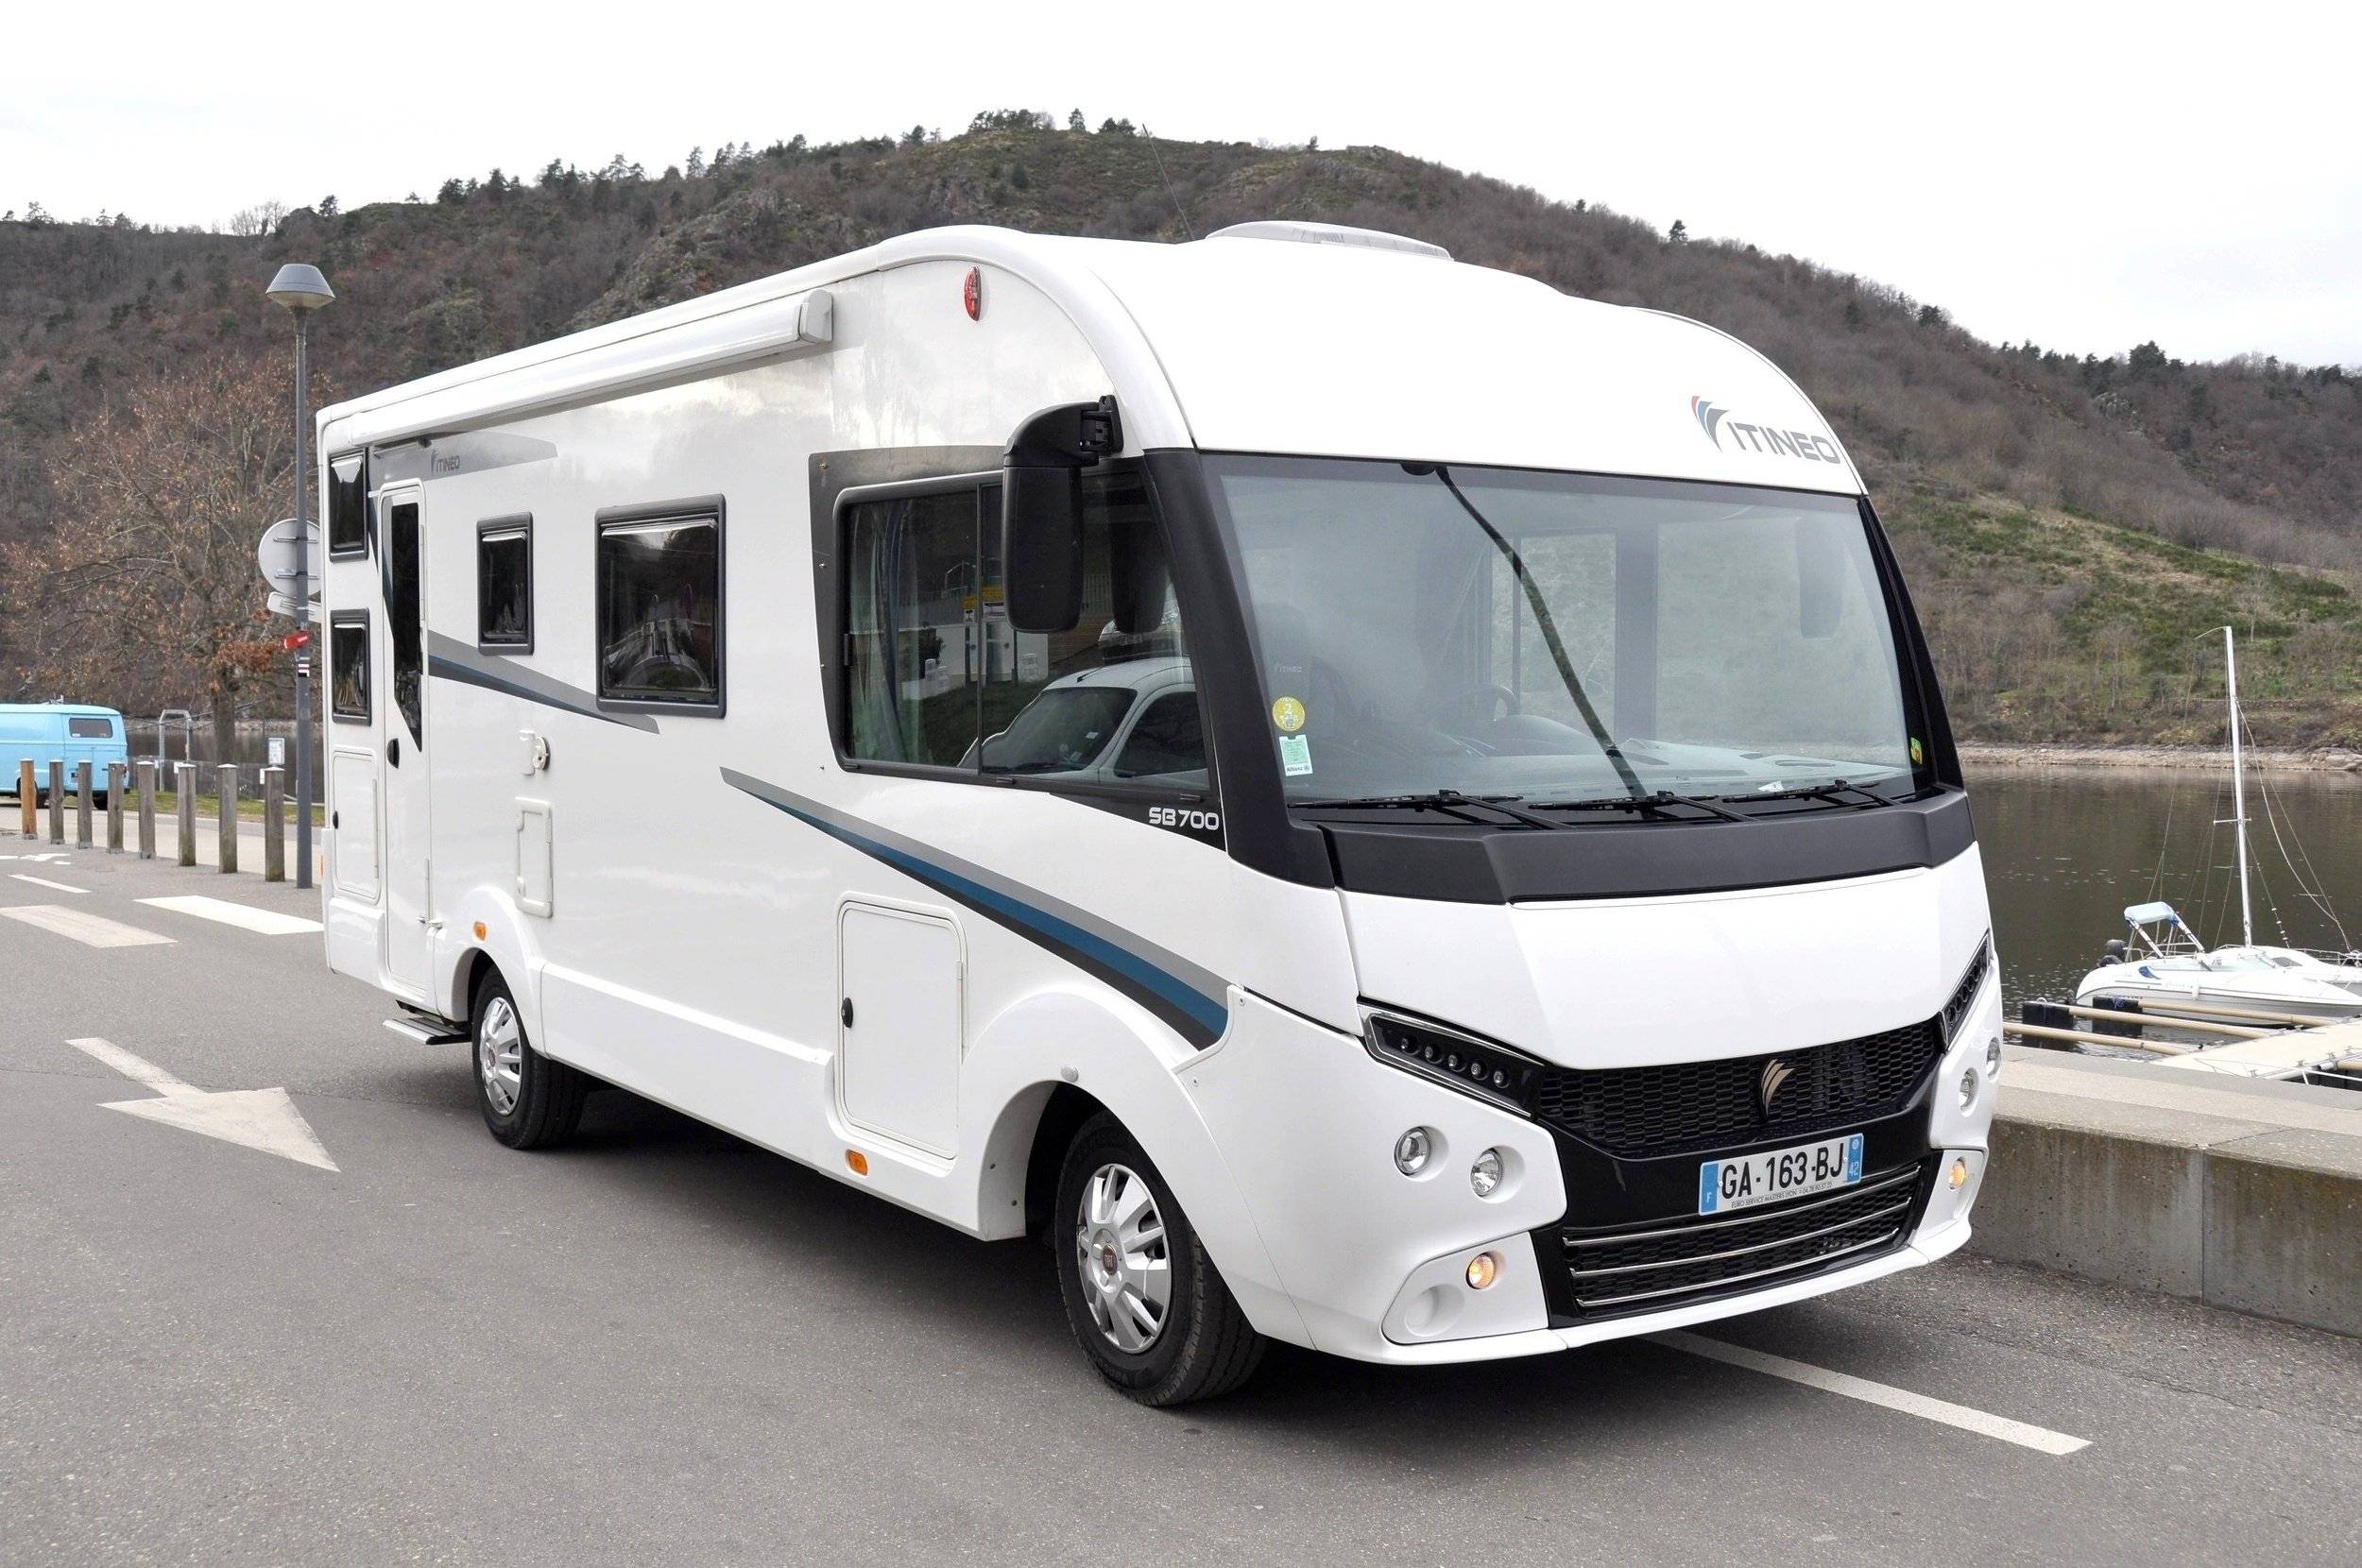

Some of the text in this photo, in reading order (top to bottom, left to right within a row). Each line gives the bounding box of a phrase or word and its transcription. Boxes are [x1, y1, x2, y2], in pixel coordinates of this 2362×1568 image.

[1726, 421, 1840, 464] ITINEO
[436, 454, 461, 472] ITINEO
[1848, 1161, 1860, 1178] 42
[1706, 1192, 1713, 1204] F
